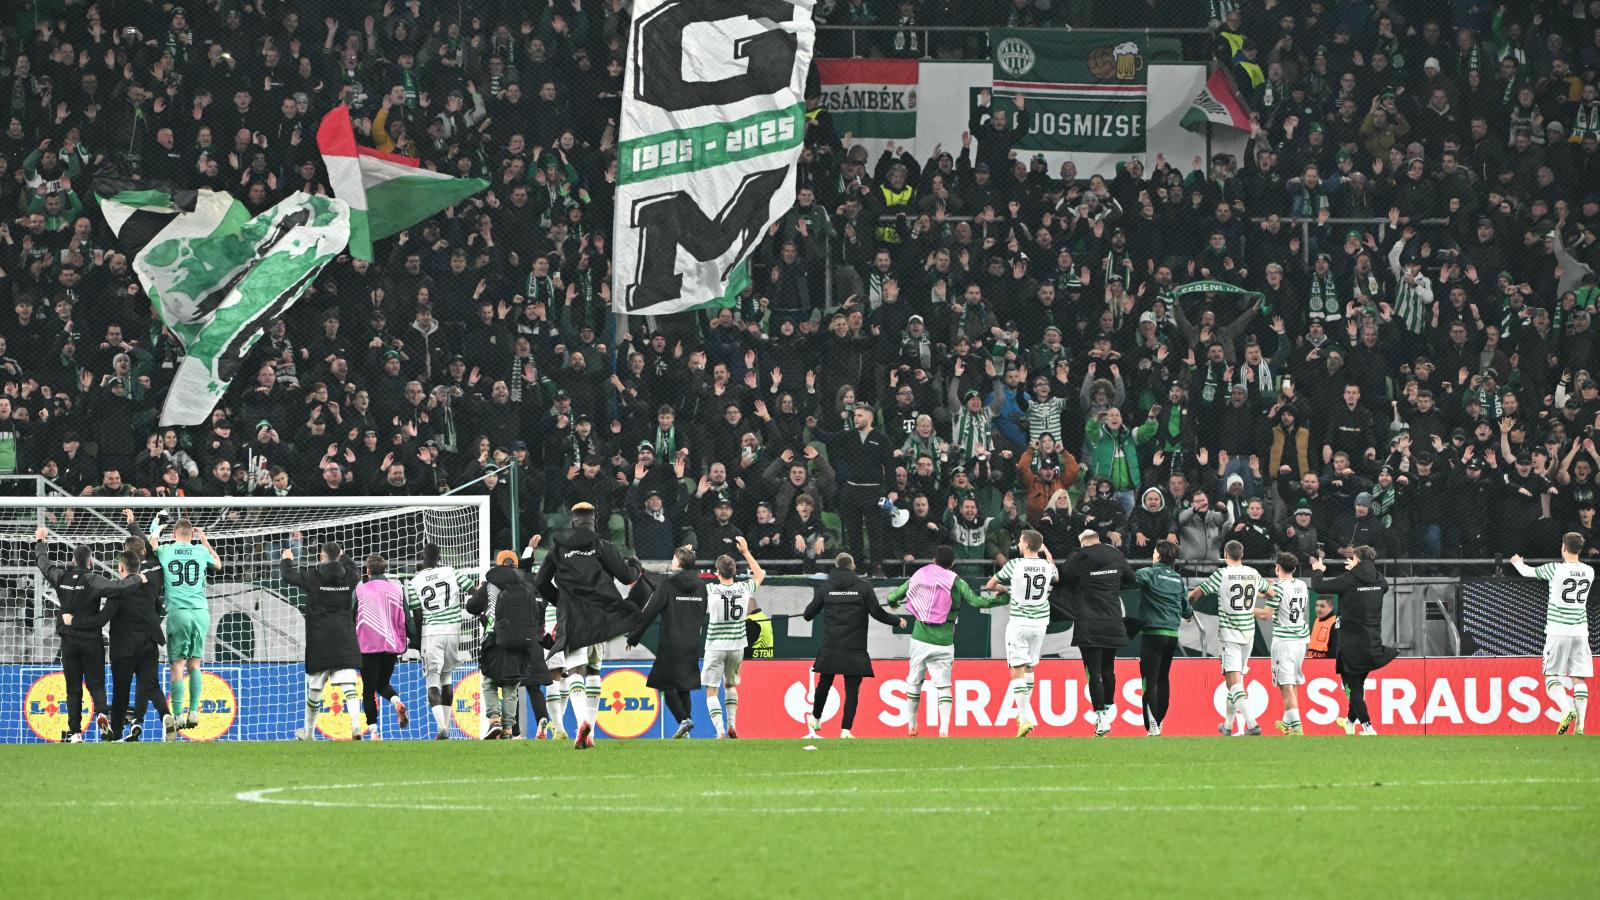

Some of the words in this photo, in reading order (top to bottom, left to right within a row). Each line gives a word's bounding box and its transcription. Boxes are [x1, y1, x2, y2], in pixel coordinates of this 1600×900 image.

[634, 0, 799, 112] G
[820, 85, 906, 111] ZSÁMBÉK
[632, 138, 693, 173] 1995
[725, 116, 795, 153] 2025
[626, 164, 792, 312] M
[167, 559, 200, 587] 90
[1023, 573, 1047, 601] 19
[421, 581, 451, 611] 27
[1230, 583, 1256, 611] 28
[1561, 578, 1591, 604] 22
[720, 594, 744, 621] 16
